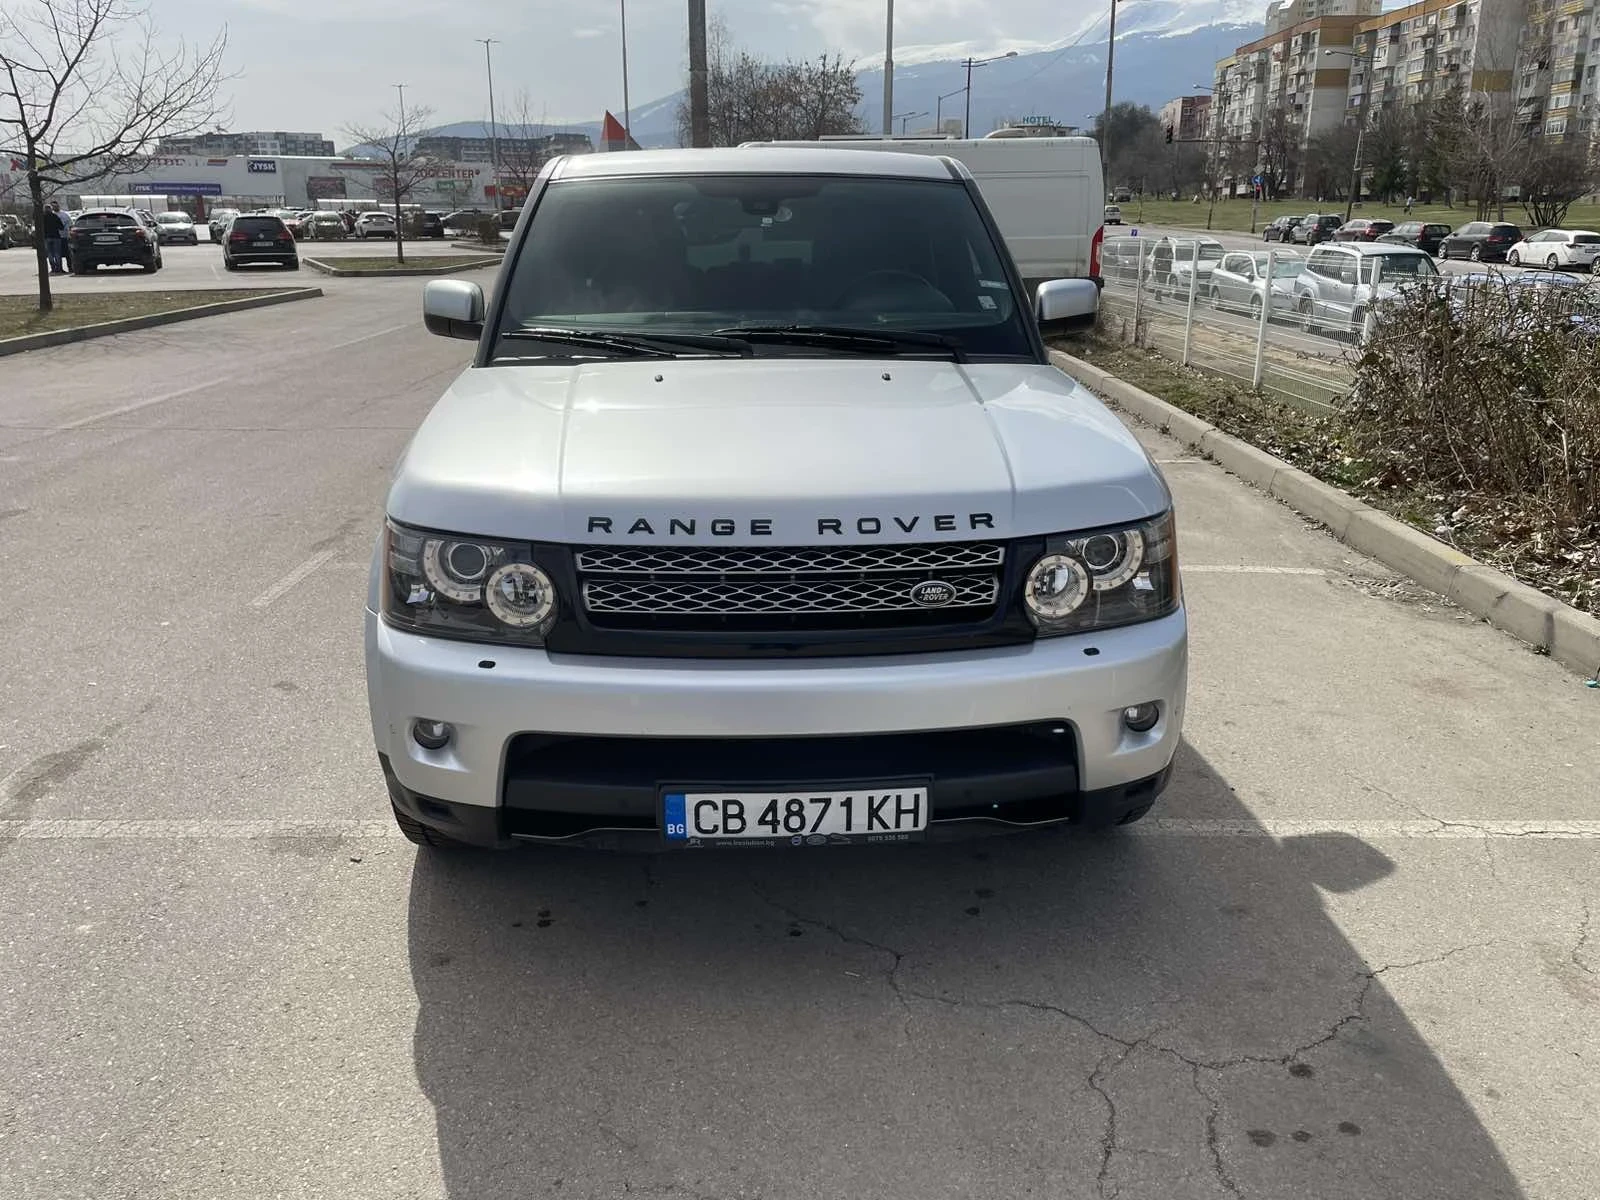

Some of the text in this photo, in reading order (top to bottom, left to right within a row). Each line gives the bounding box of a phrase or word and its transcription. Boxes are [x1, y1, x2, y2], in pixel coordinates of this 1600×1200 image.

[1023, 115, 1053, 124] HOTEL
[253, 162, 275, 171] JYSK
[588, 512, 996, 536] RANGE ROVER
[923, 593, 949, 601] ROVER
[693, 793, 921, 835] CB 4871 KH
[667, 823, 685, 834] BG
